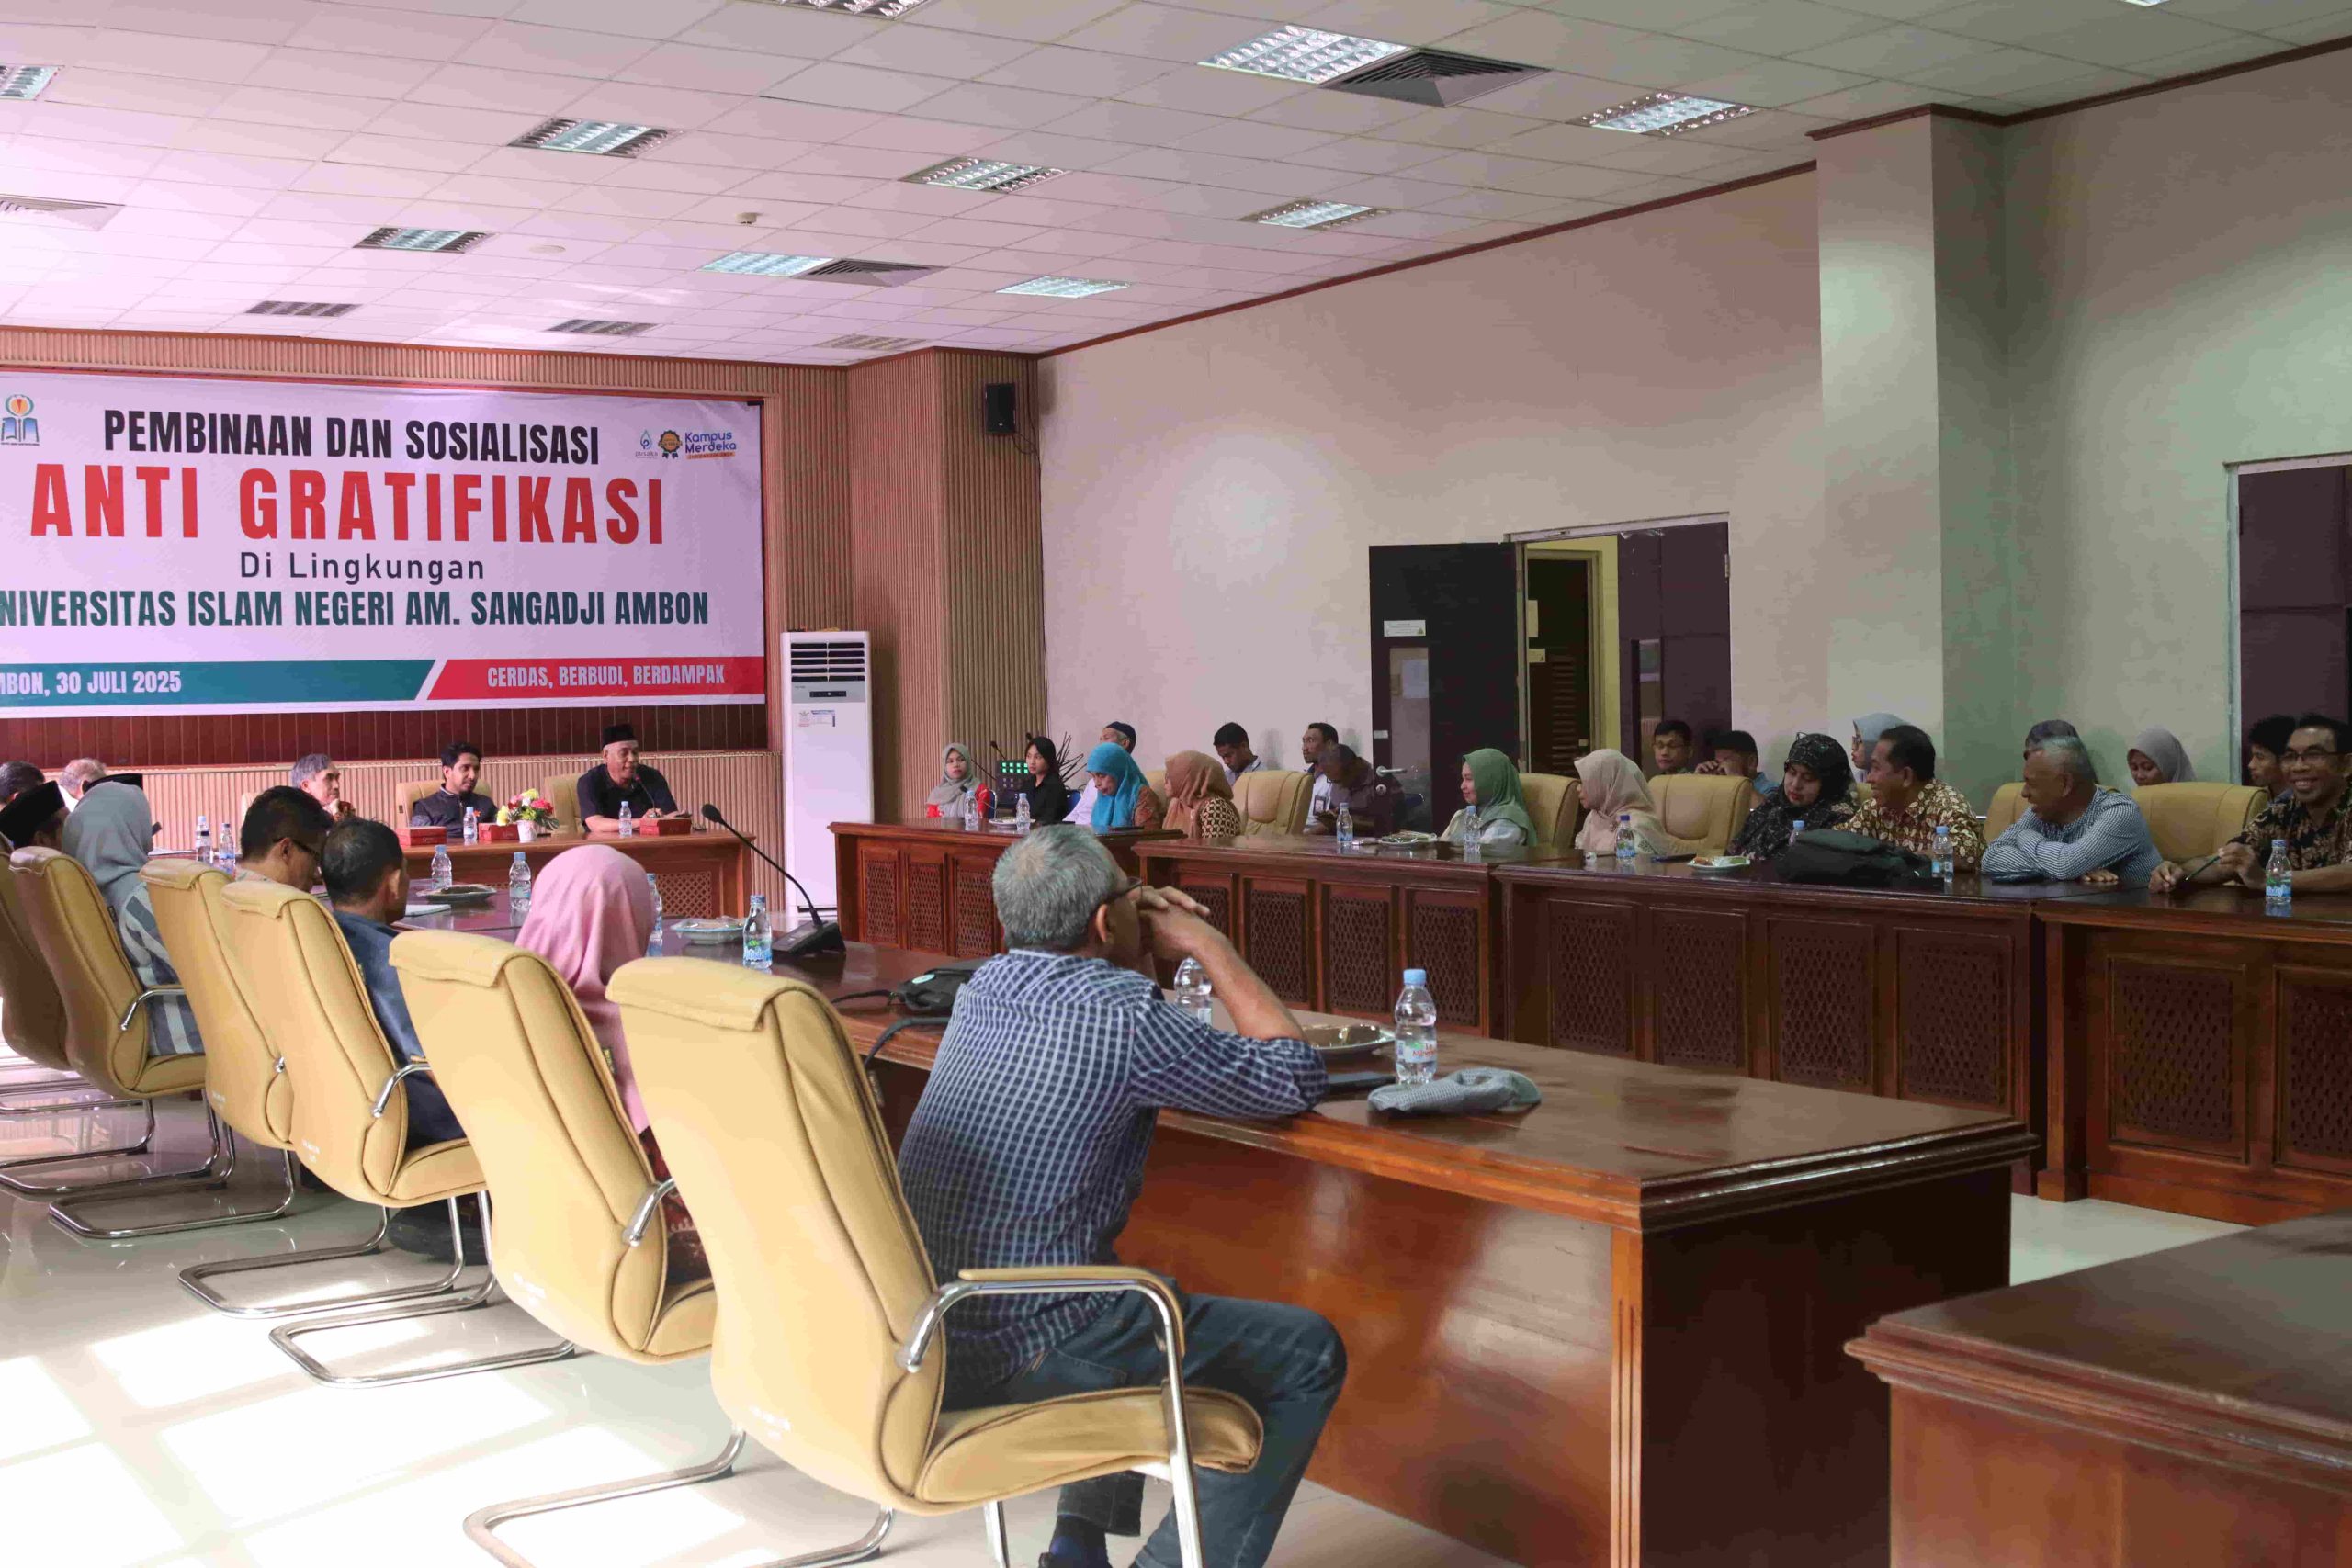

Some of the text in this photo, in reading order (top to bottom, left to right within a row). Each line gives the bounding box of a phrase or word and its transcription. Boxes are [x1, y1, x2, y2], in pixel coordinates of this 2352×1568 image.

[105, 410, 599, 465] PEMBINAAN DAN SOSIALISASI
[684, 431, 733, 444] Kampus
[684, 441, 737, 454] Merdeka
[30, 463, 663, 545] ANTI GRATIFIKASI
[241, 552, 484, 585] Di Lingkungan
[187, 591, 282, 626] ISLAM
[295, 591, 394, 626] NEGERI
[405, 591, 460, 626] AM.
[470, 591, 605, 626] SANGADJI
[615, 592, 708, 625] AMBON
[56, 672, 82, 694] 30
[86, 671, 127, 694] JULI
[132, 671, 182, 694] 2025
[487, 664, 725, 689] CERDAS, BERBUDI, BERDAMPAK
